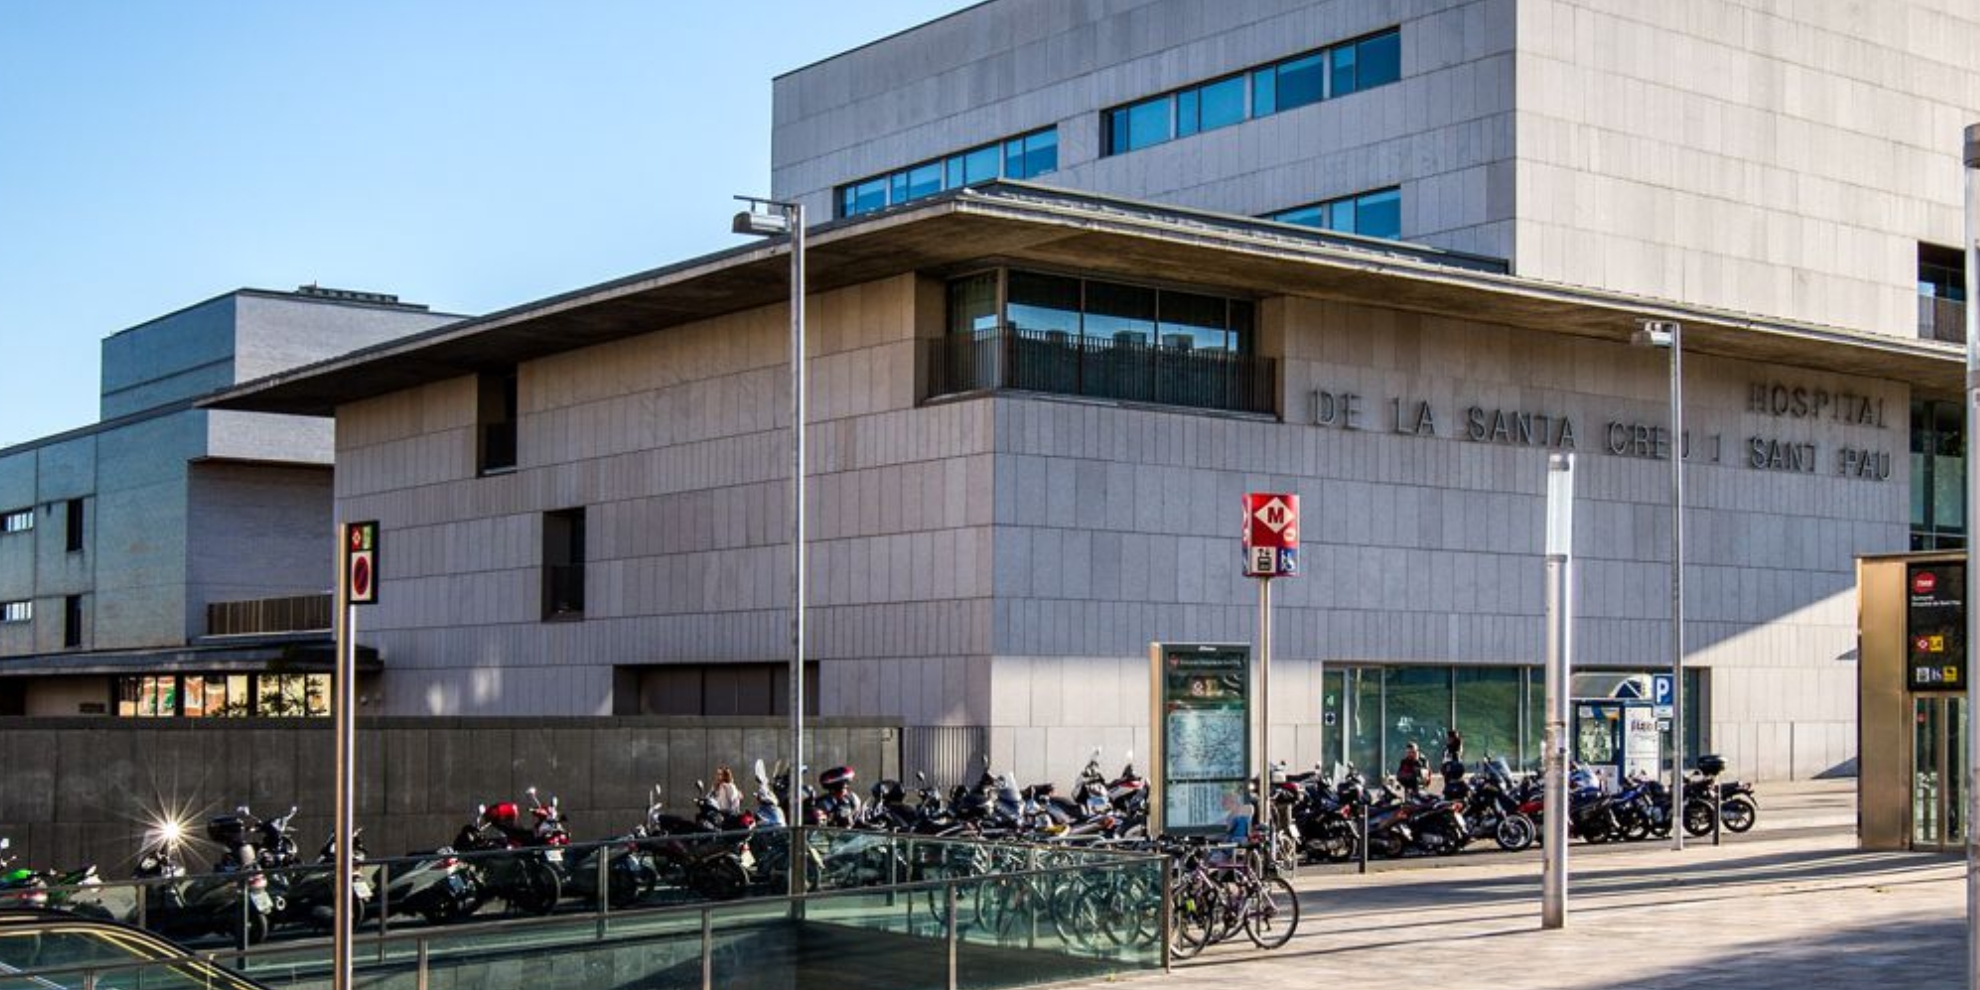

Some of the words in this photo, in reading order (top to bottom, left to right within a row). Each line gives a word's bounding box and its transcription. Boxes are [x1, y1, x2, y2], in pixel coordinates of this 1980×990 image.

[1747, 382, 1888, 429] HOSPITAL
[1312, 388, 1362, 430] DE
[1393, 397, 1436, 436] LA
[1466, 405, 1575, 449] SANTA
[1748, 434, 1816, 472] SANT
[1838, 446, 1891, 481] PAU
[1267, 506, 1284, 524] M
[1656, 677, 1670, 704] P
